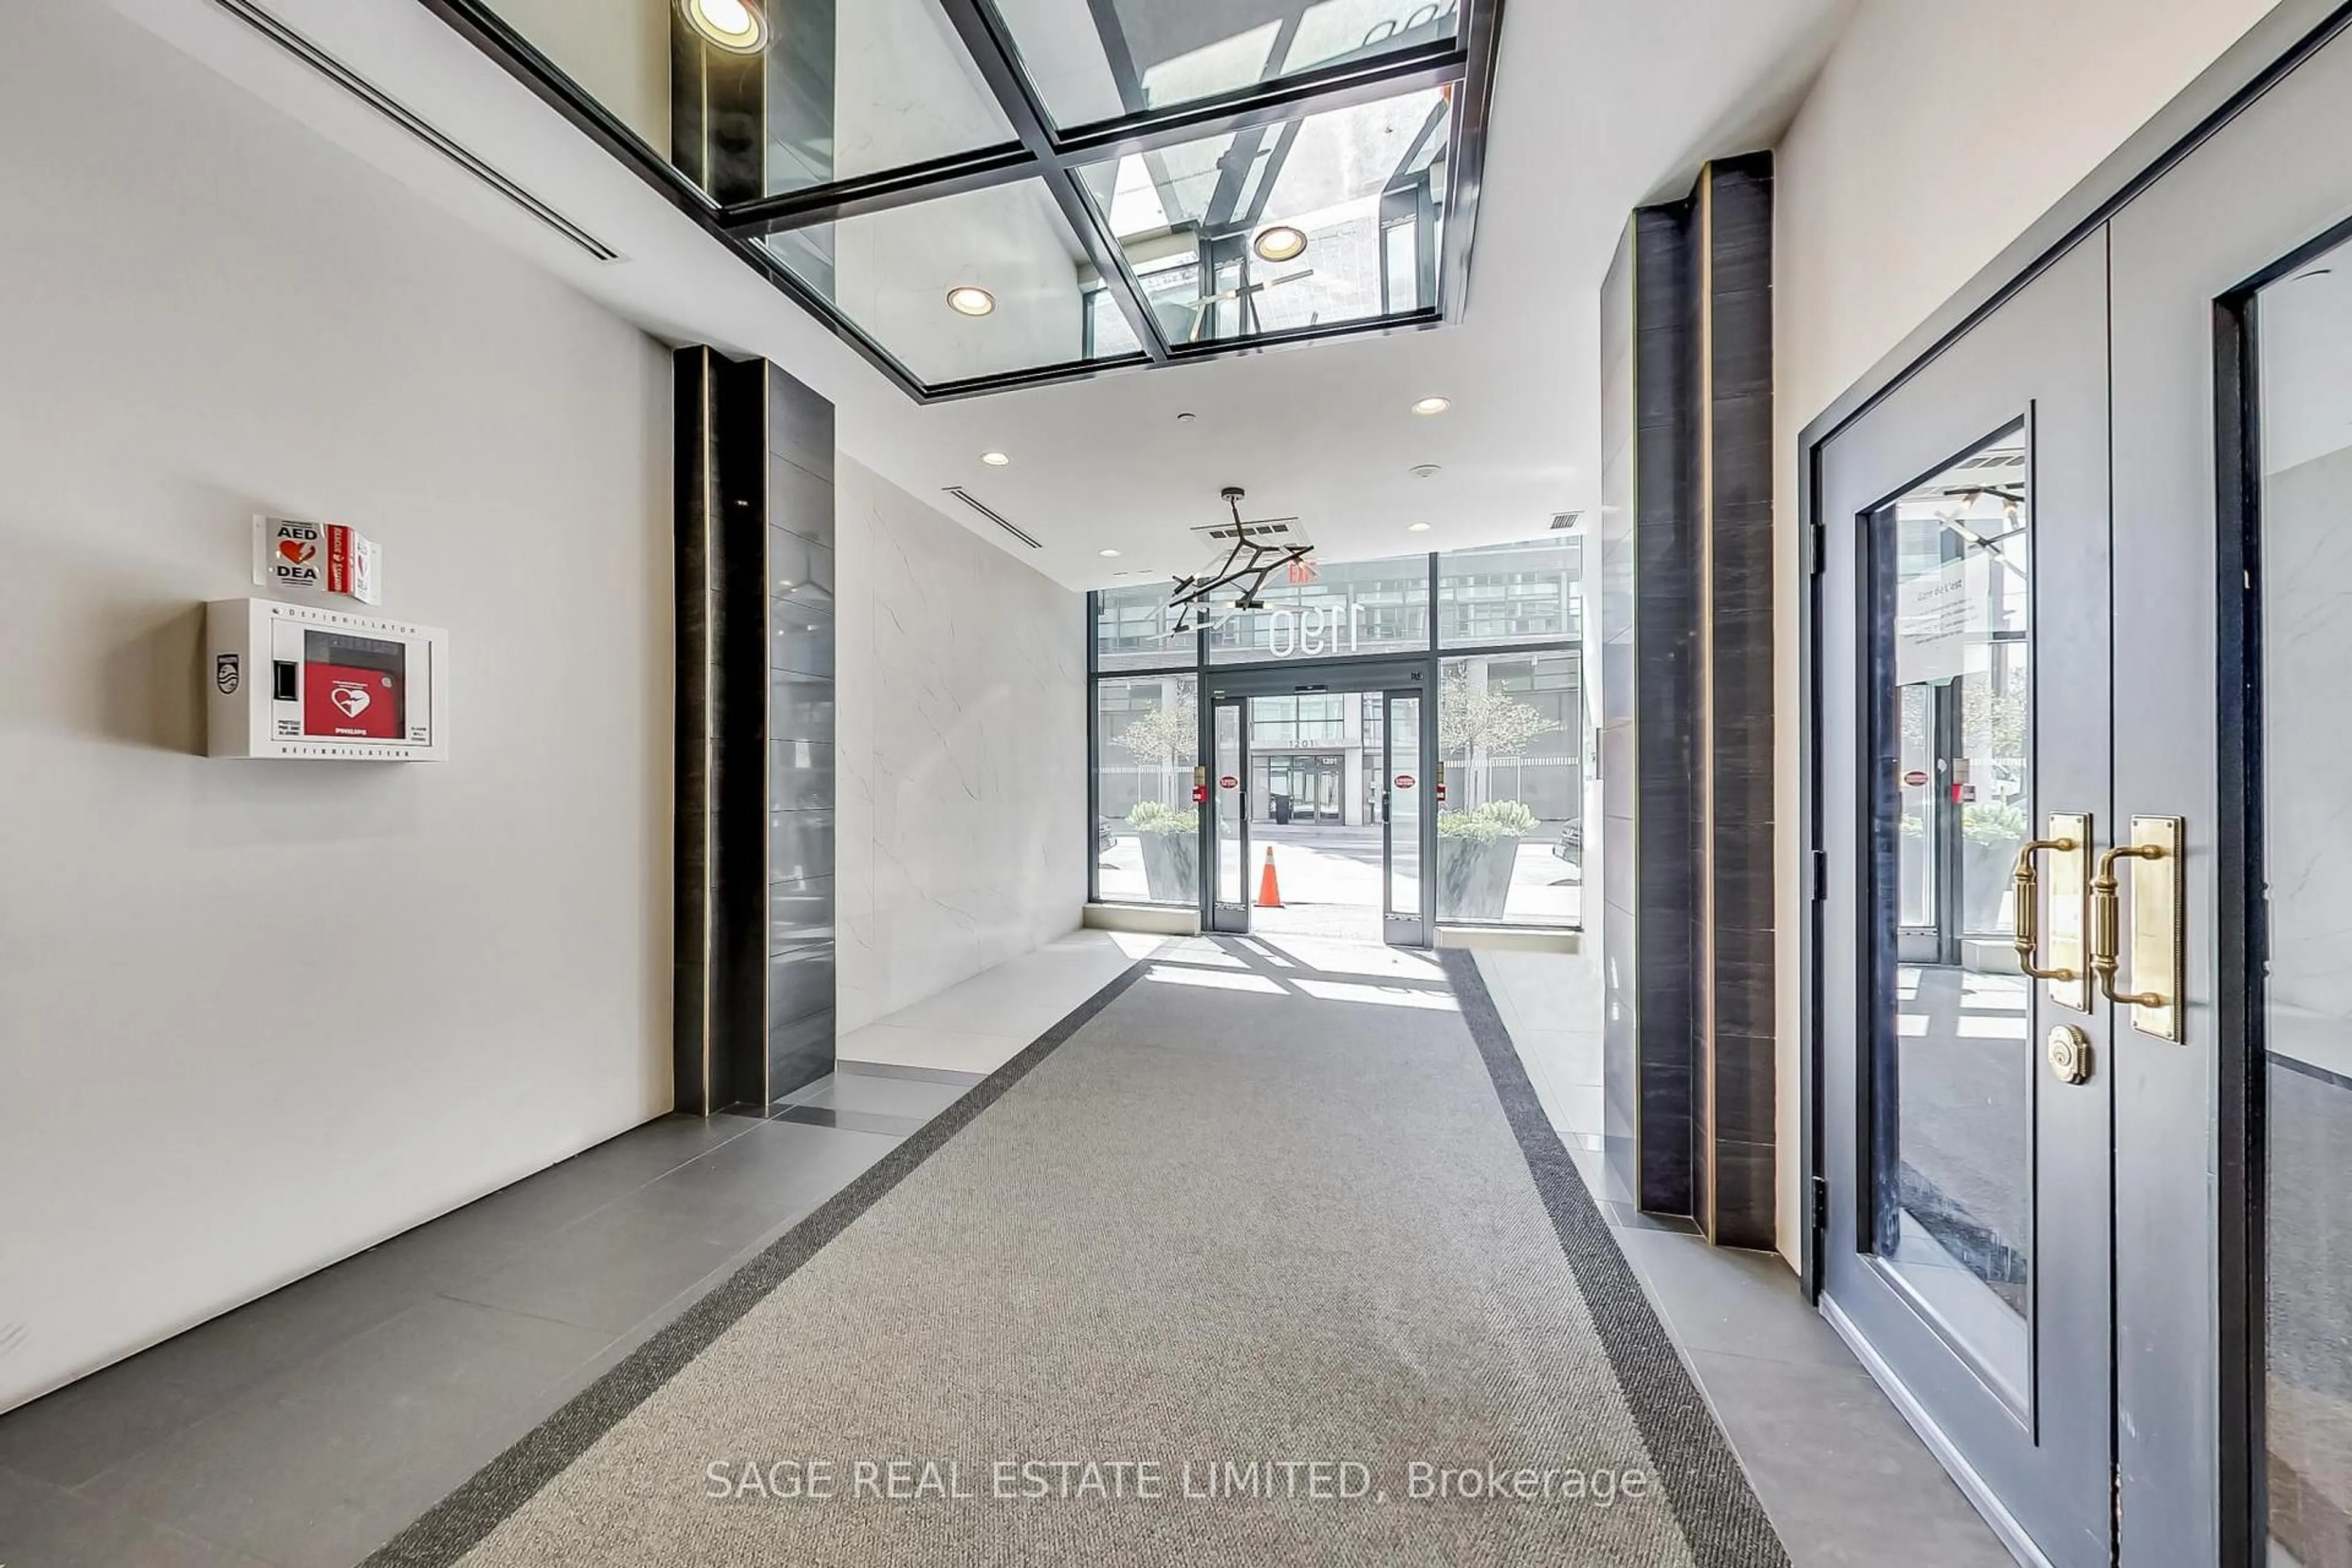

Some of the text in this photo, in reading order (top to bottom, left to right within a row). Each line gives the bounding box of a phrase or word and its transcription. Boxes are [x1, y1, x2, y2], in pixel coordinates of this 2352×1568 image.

[277, 526, 317, 540] AED
[277, 565, 317, 579] DEA
[288, 609, 416, 633] DEFIBRILLATOR
